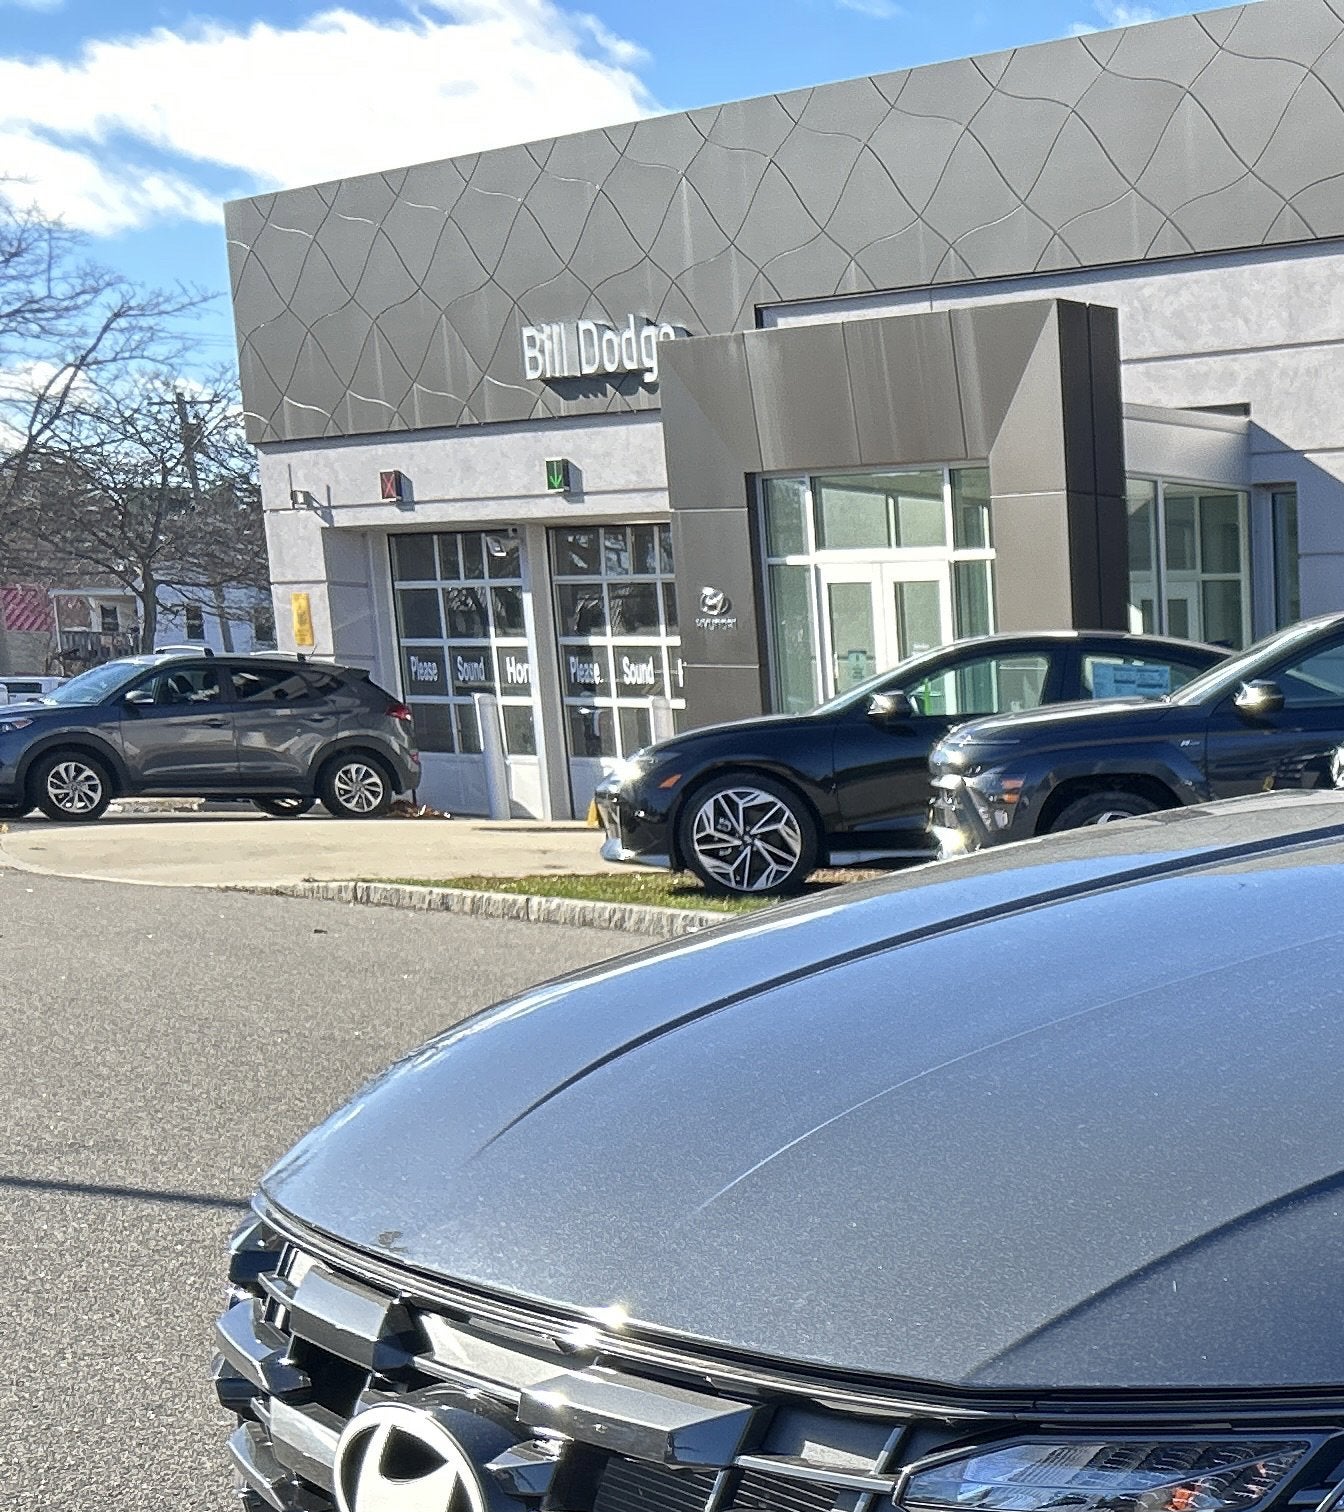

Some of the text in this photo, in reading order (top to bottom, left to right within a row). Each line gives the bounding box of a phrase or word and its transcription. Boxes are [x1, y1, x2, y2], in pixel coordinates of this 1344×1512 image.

[521, 322, 569, 381] Bill
[410, 655, 530, 684] Please Sound Hor
[569, 656, 655, 685] Please Sound
